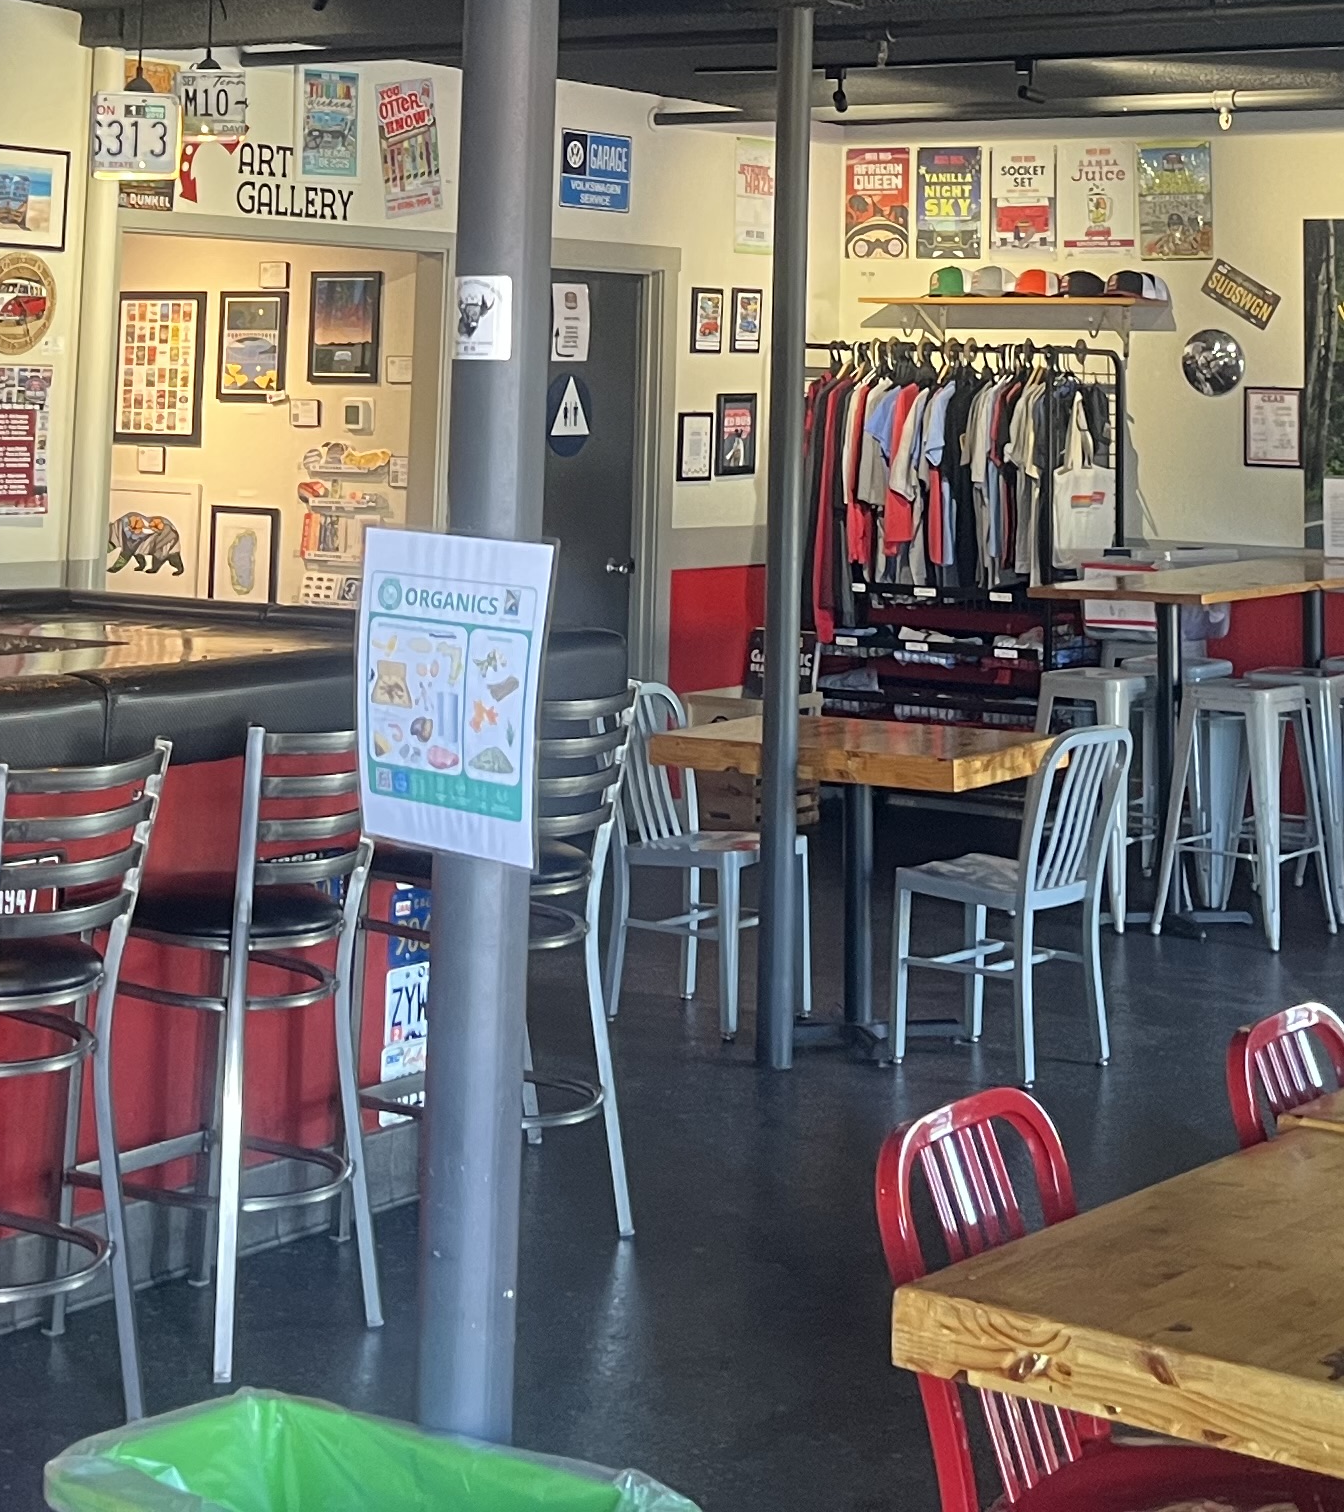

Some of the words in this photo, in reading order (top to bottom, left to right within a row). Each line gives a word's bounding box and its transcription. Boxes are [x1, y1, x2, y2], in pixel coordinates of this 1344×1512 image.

[379, 85, 401, 100] YOU
[238, 142, 294, 178] ART
[590, 146, 629, 173] GARAGE
[924, 172, 973, 183] VANILLA
[1000, 165, 1046, 176] SOCKET
[1071, 166, 1126, 183] Juice
[570, 180, 622, 195] VOLKSWAGEN
[853, 175, 903, 190] QUEEN
[1013, 177, 1034, 188] SET
[924, 185, 972, 198] NIGHT
[129, 193, 171, 208] DUNKEL
[236, 180, 355, 222] GALLERY
[579, 193, 611, 207] SERVICE
[924, 199, 972, 216] SKY
[1207, 271, 1273, 323] SUDSWGN
[404, 586, 500, 617] ORGANICS
